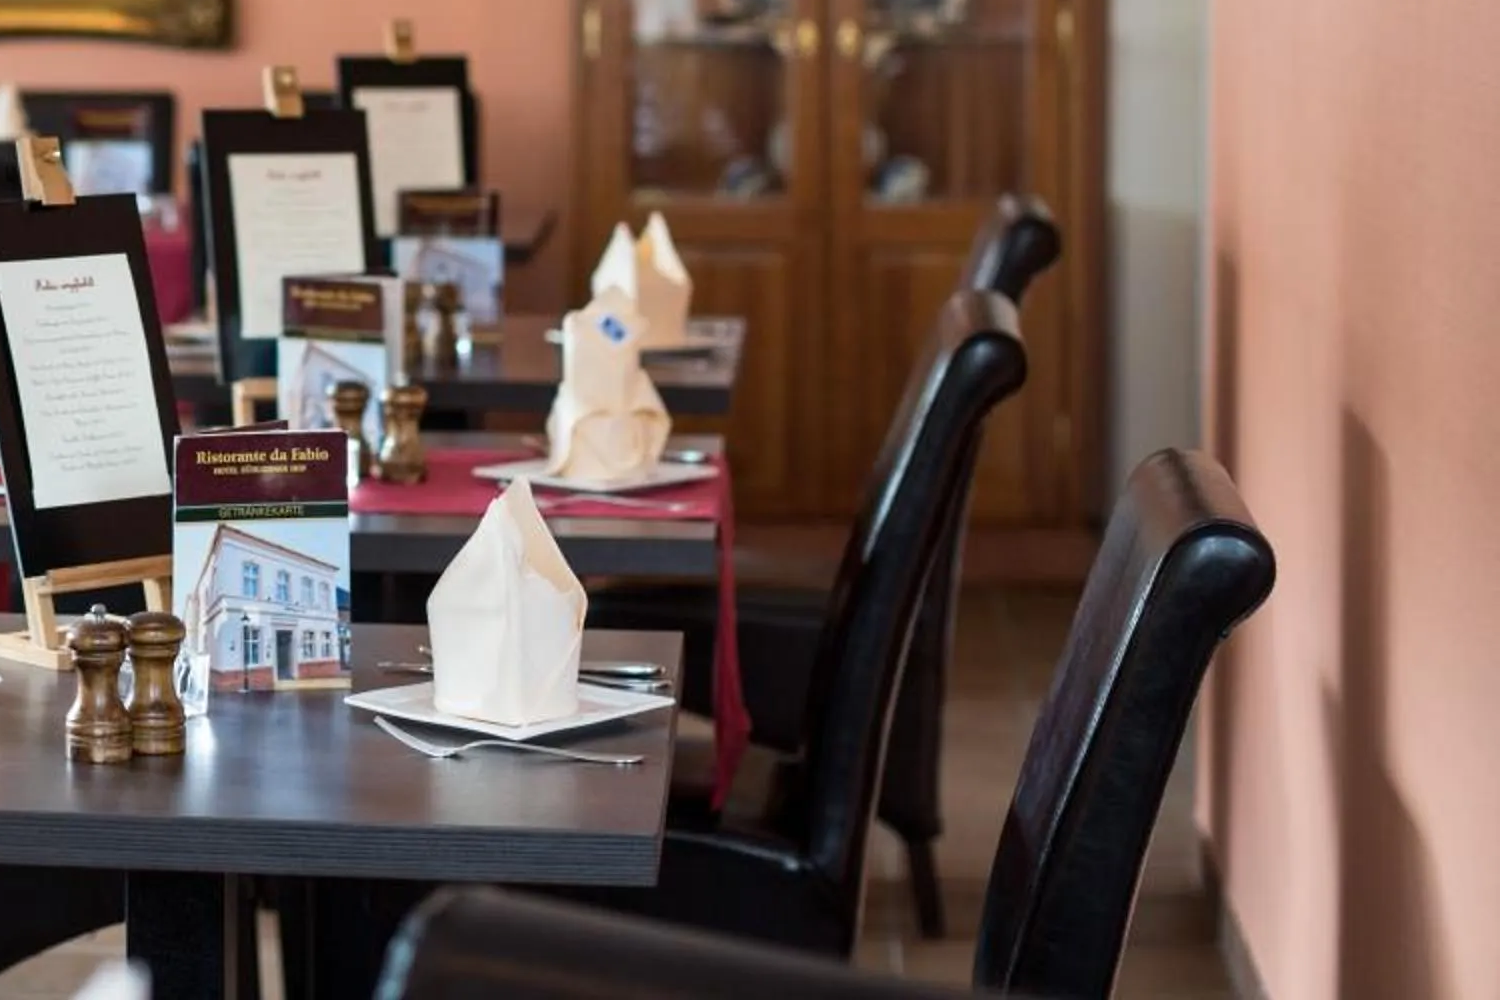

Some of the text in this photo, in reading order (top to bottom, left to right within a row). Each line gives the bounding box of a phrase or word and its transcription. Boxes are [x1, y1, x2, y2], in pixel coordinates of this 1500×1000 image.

[196, 446, 330, 465] Ristorante da Fabio
